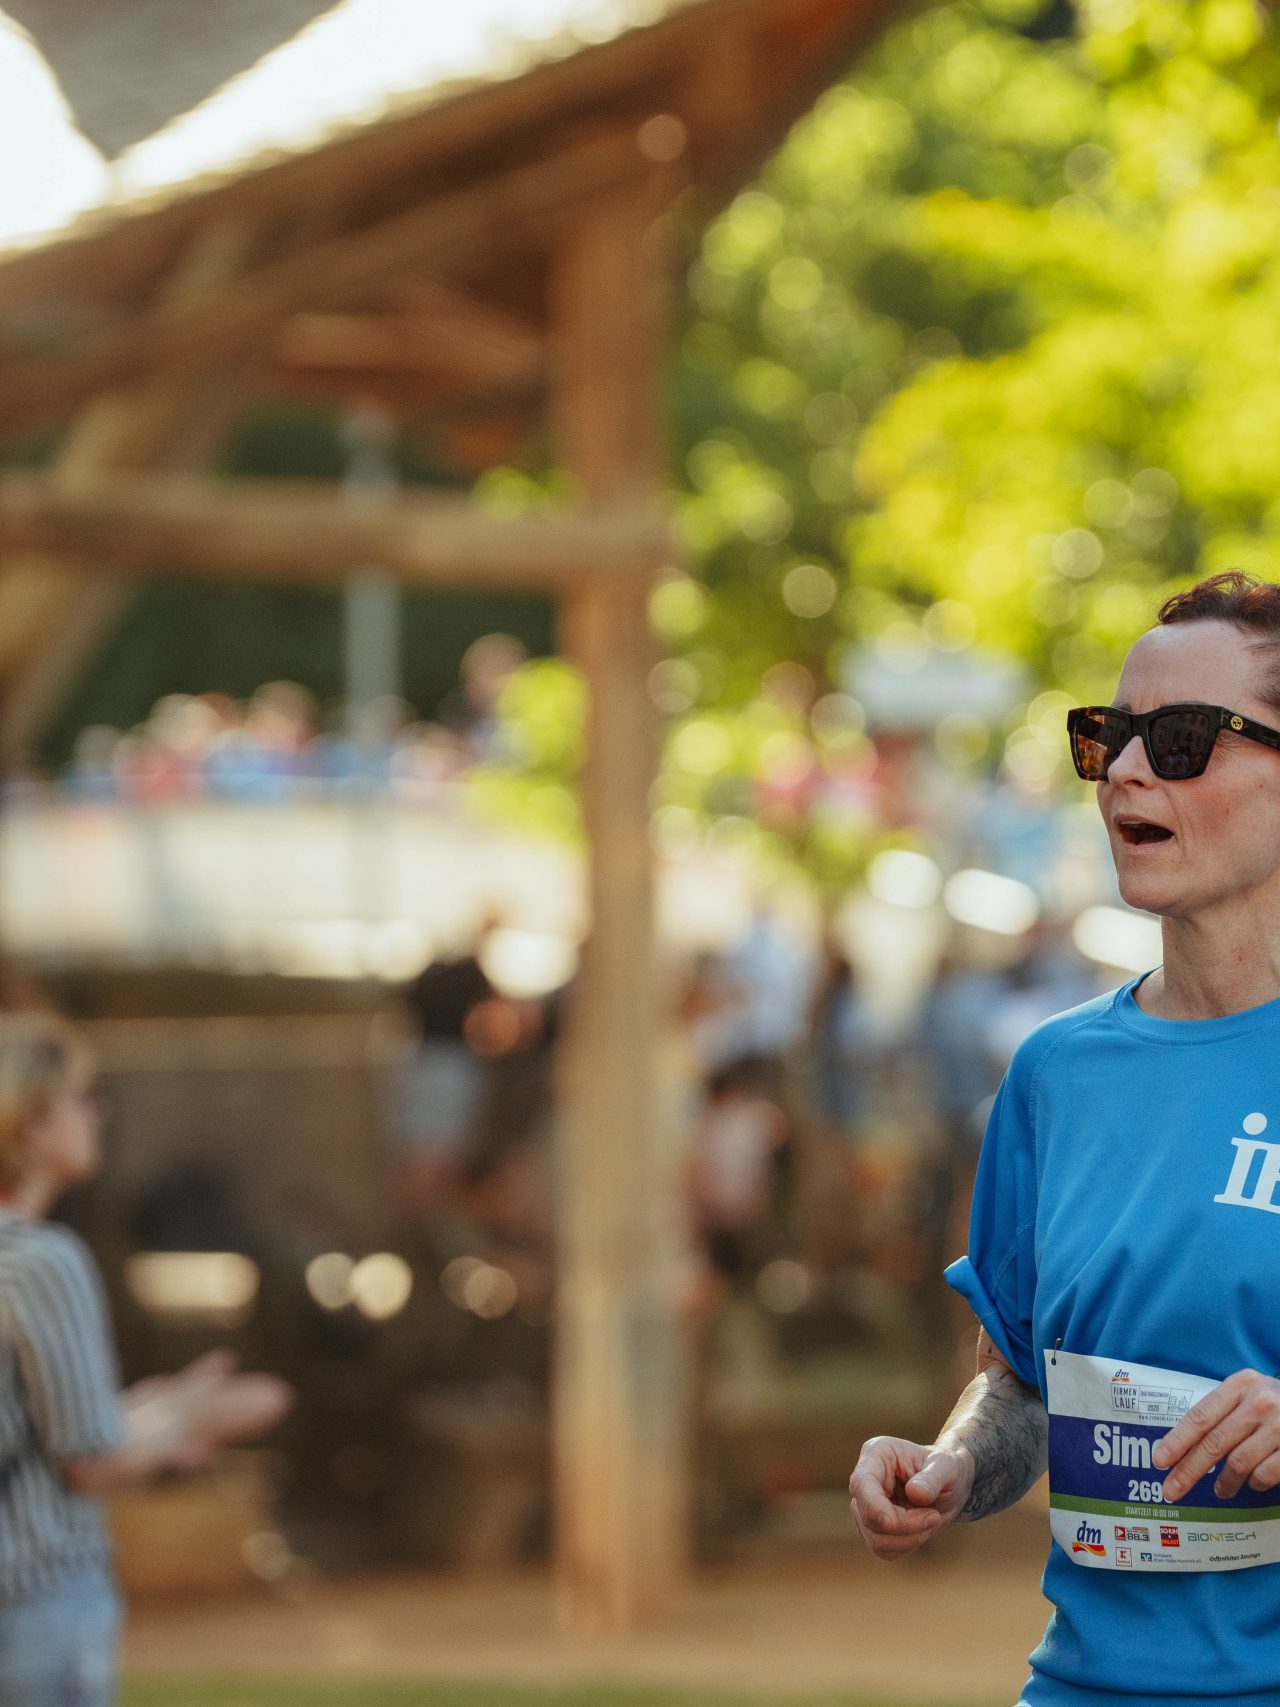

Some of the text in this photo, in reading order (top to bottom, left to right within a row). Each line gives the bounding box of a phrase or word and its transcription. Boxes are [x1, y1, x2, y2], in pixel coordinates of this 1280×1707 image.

[1115, 1369, 1129, 1378] dm
[1113, 1386, 1137, 1397] FIRMEN
[1114, 1397, 1136, 1409] LAUF
[1093, 1423, 1215, 1473] Sim
[1128, 1479, 1174, 1504] 269
[1124, 1506, 1152, 1517] STARTZEIT
[1167, 1510, 1180, 1518] UHR
[1076, 1520, 1102, 1544] dm
[1127, 1533, 1150, 1542] 88.3
